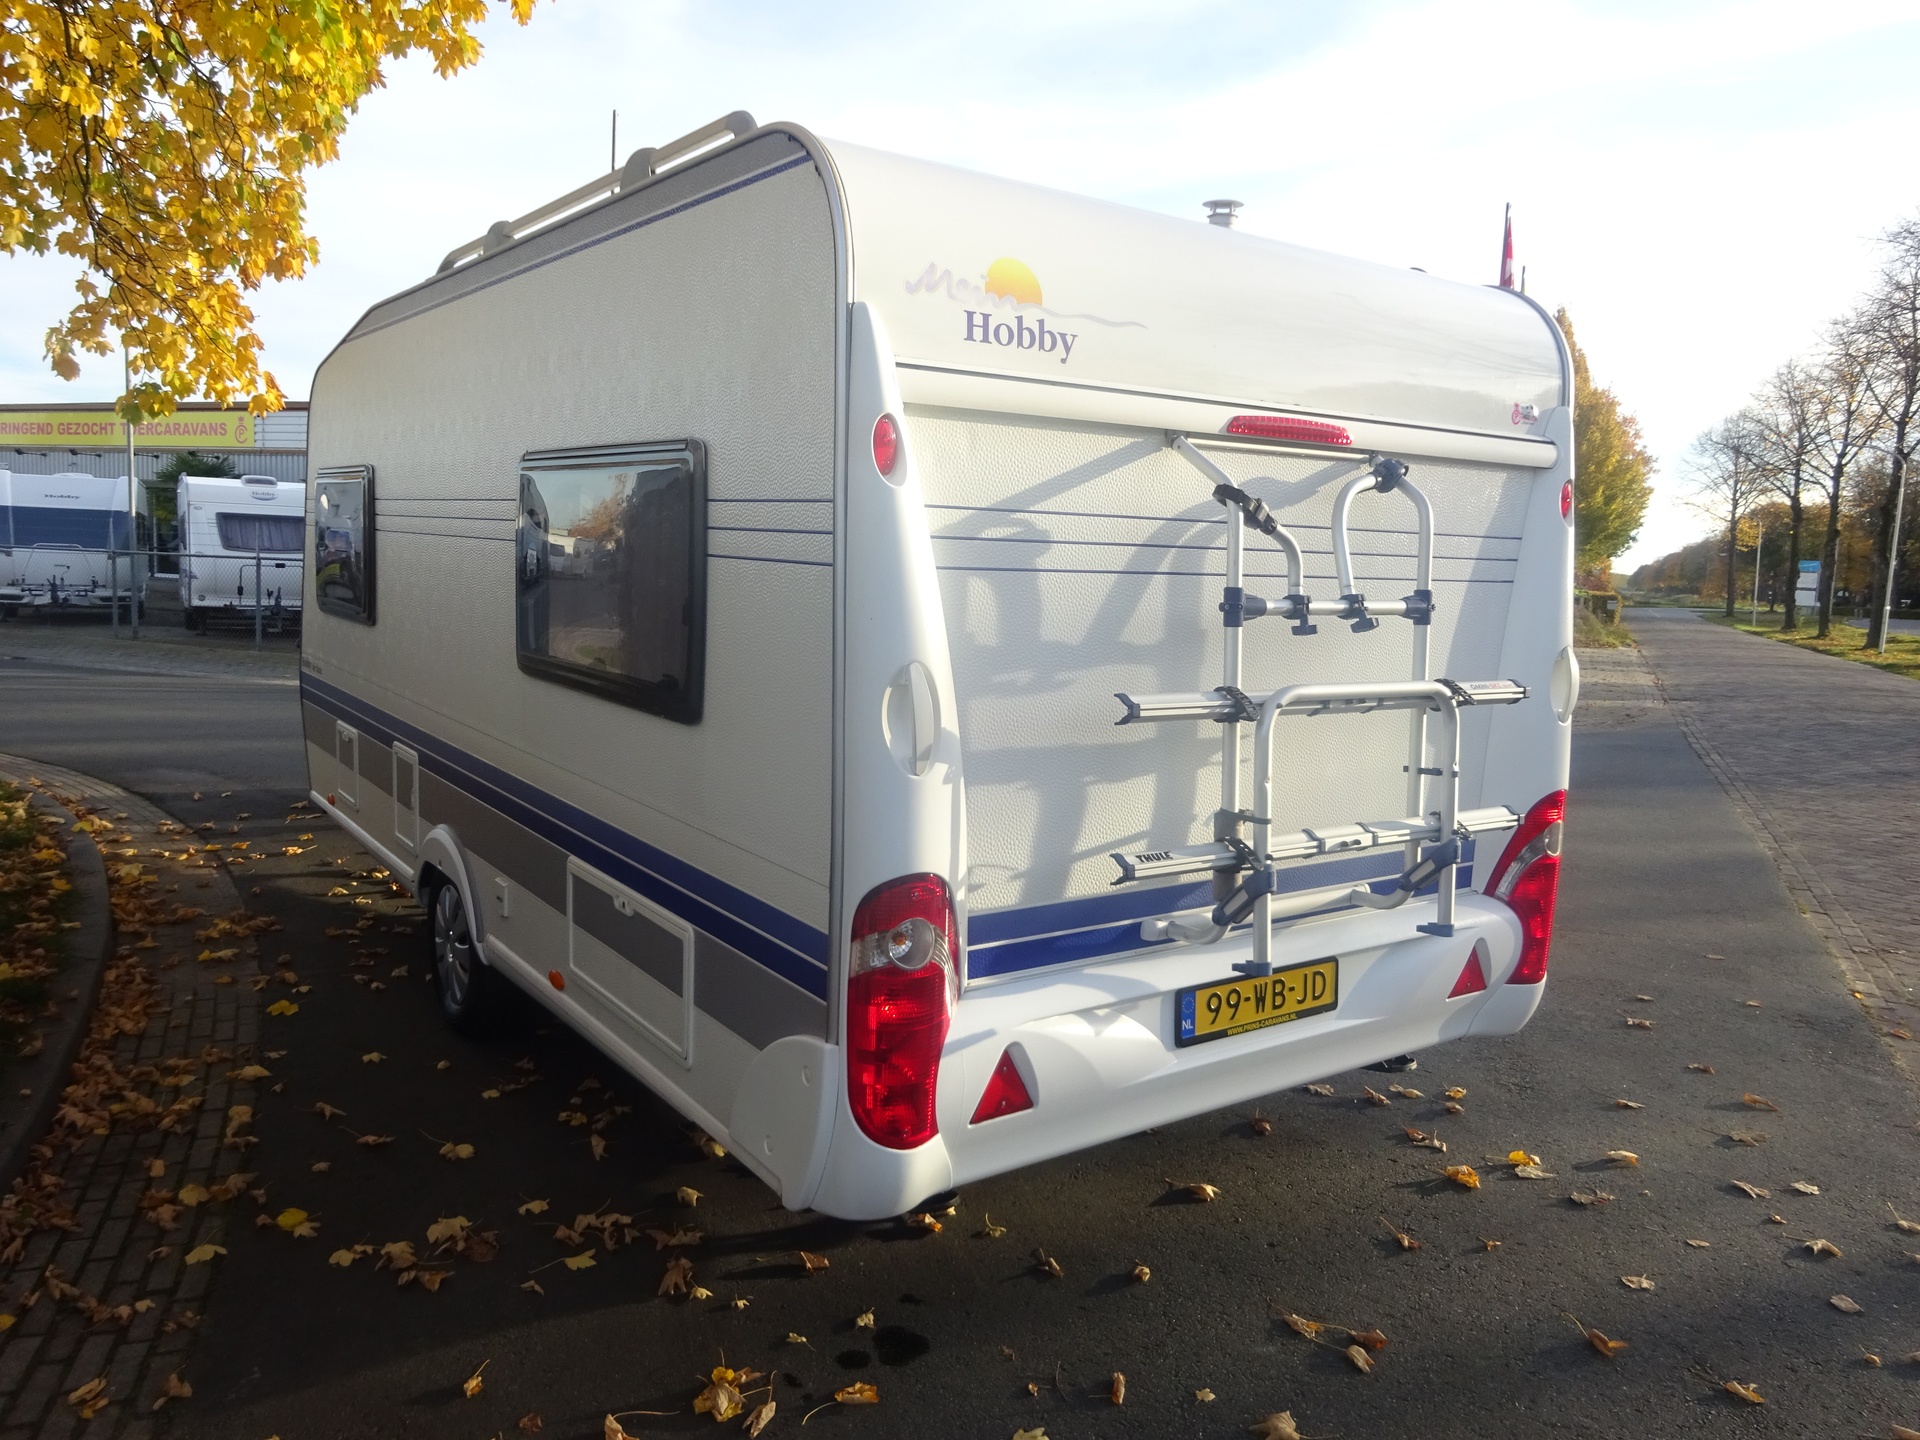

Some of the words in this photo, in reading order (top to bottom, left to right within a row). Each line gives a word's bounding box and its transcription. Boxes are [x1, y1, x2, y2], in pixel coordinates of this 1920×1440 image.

[962, 309, 1079, 365] Hobby
[0, 422, 53, 436] RINGEND
[57, 422, 116, 436] GEZOCHT
[251, 490, 276, 498] Hobby
[1135, 850, 1173, 864] THULE
[1206, 969, 1327, 1026] 99-WB-JD
[1181, 1018, 1195, 1031] NL
[1226, 1013, 1299, 1037] WWW.PRINS-CARAVANS.NL
